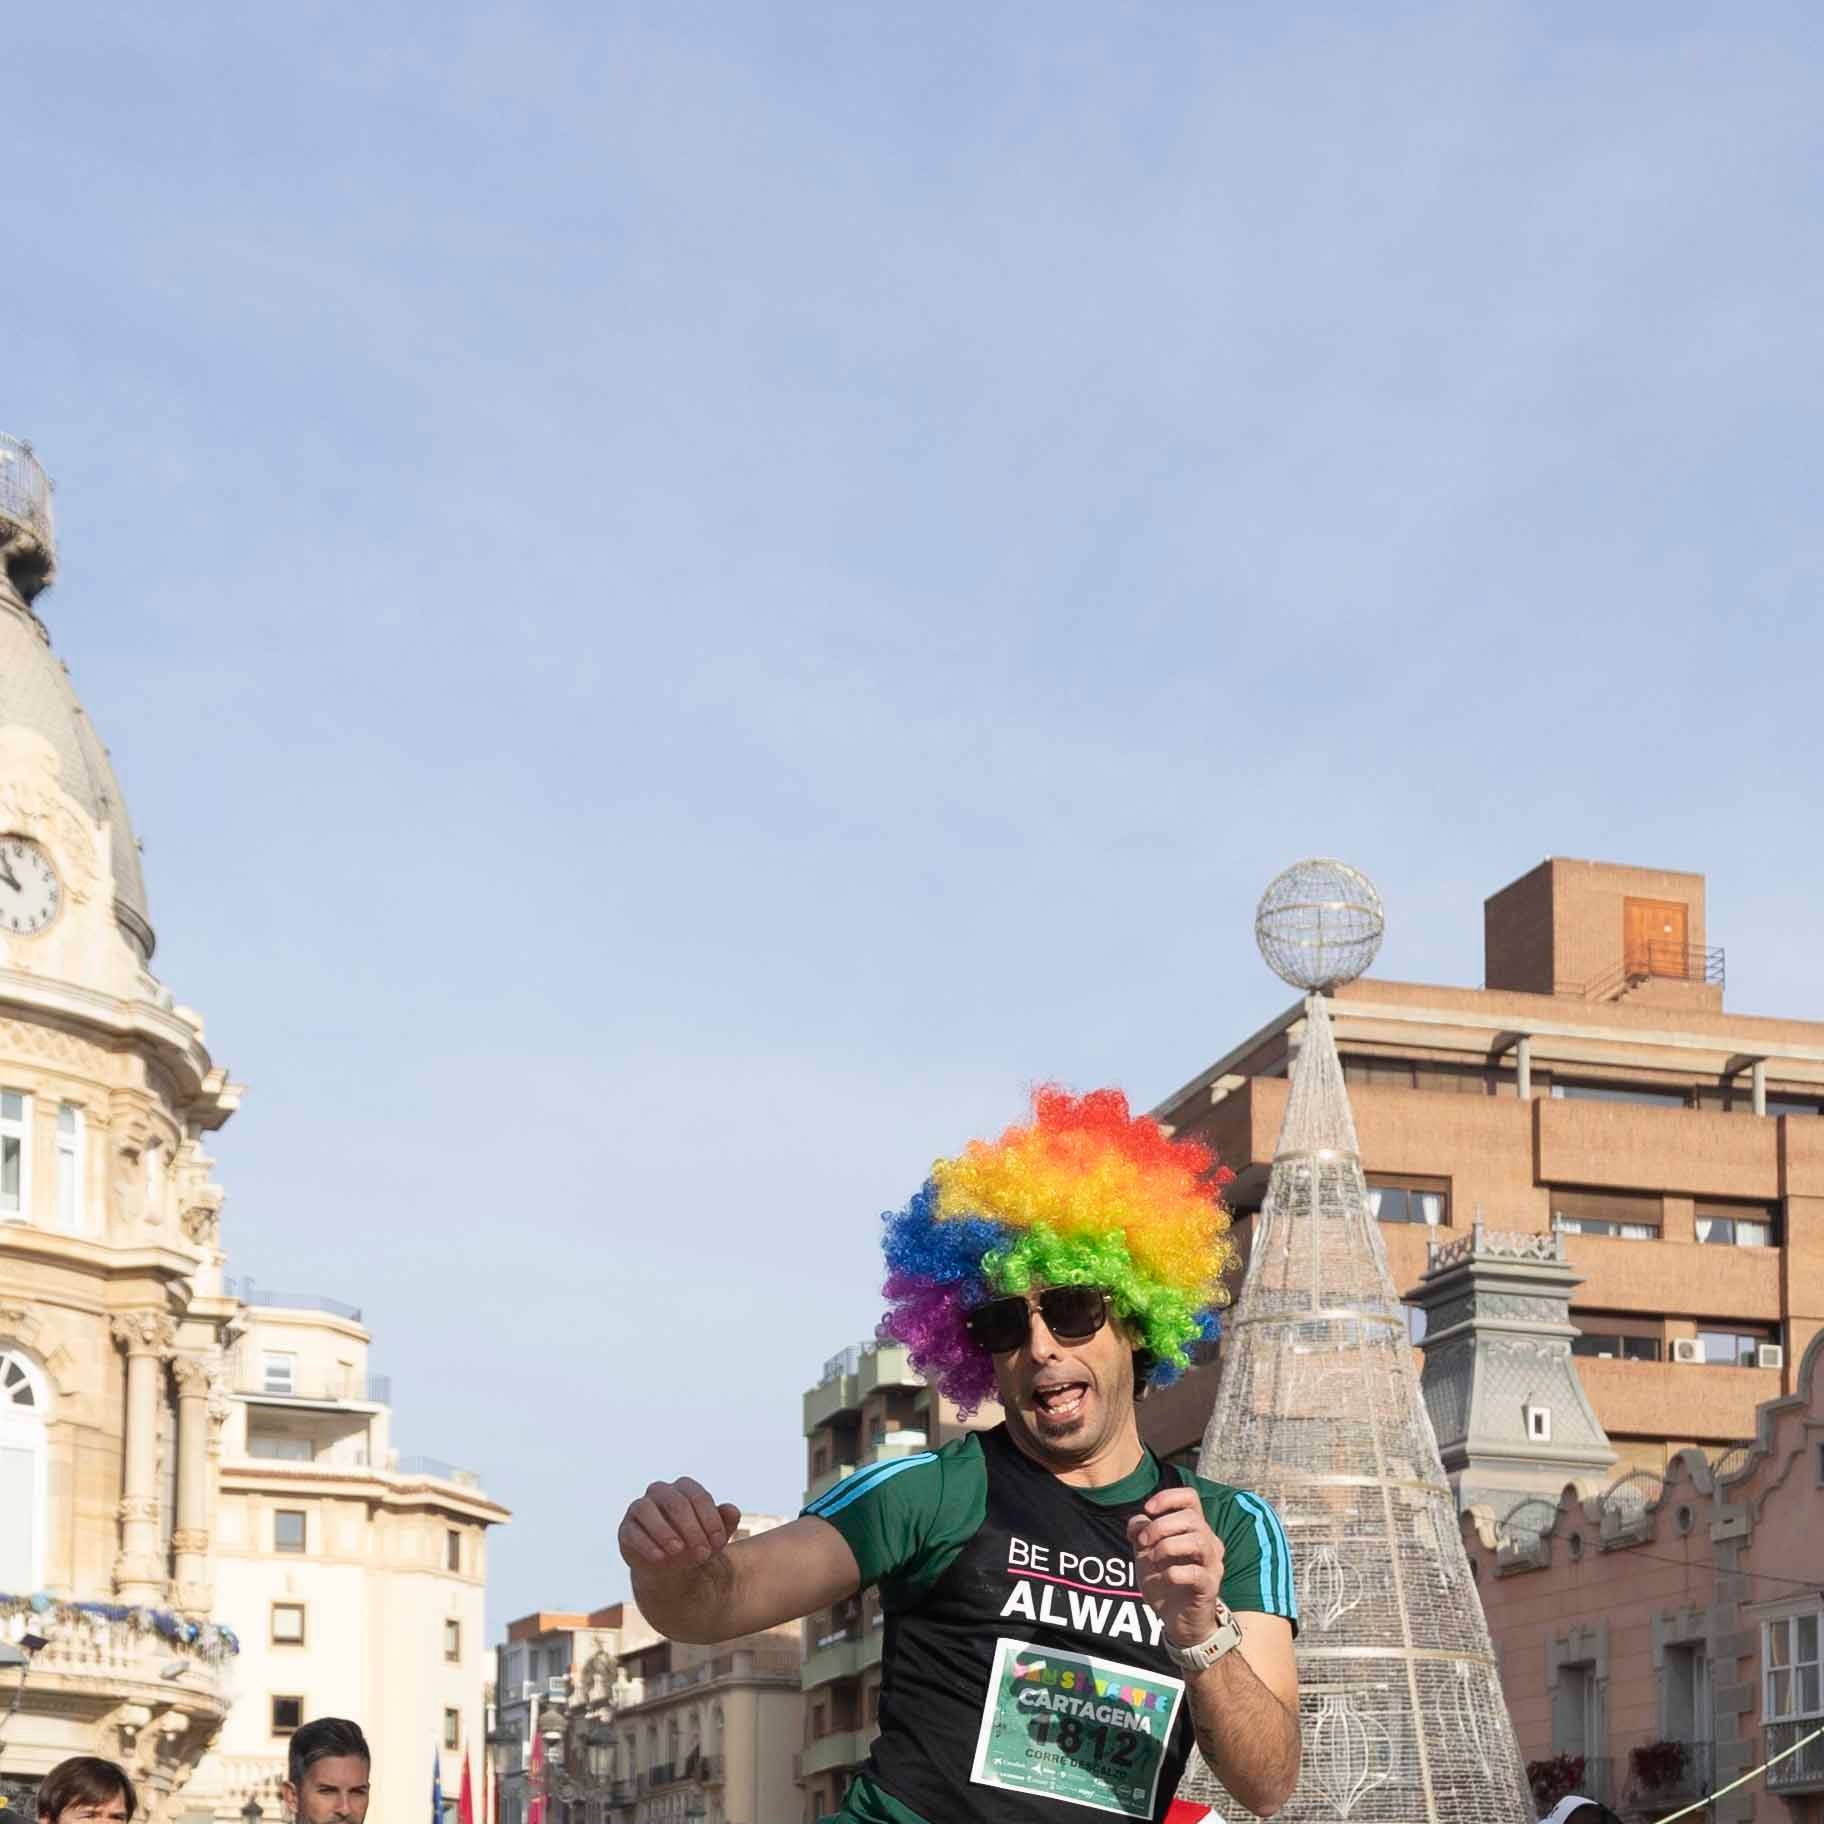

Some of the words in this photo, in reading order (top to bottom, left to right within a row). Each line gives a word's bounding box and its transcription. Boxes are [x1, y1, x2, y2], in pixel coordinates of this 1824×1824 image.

[1008, 1537, 1050, 1572] BE
[1059, 1551, 1134, 1587] POSI
[999, 1580, 1165, 1646] ALWAY
[1019, 1688, 1152, 1734] CARTAGENA
[1025, 1748, 1067, 1767] CORRE
[1027, 1712, 1137, 1768] 1812
